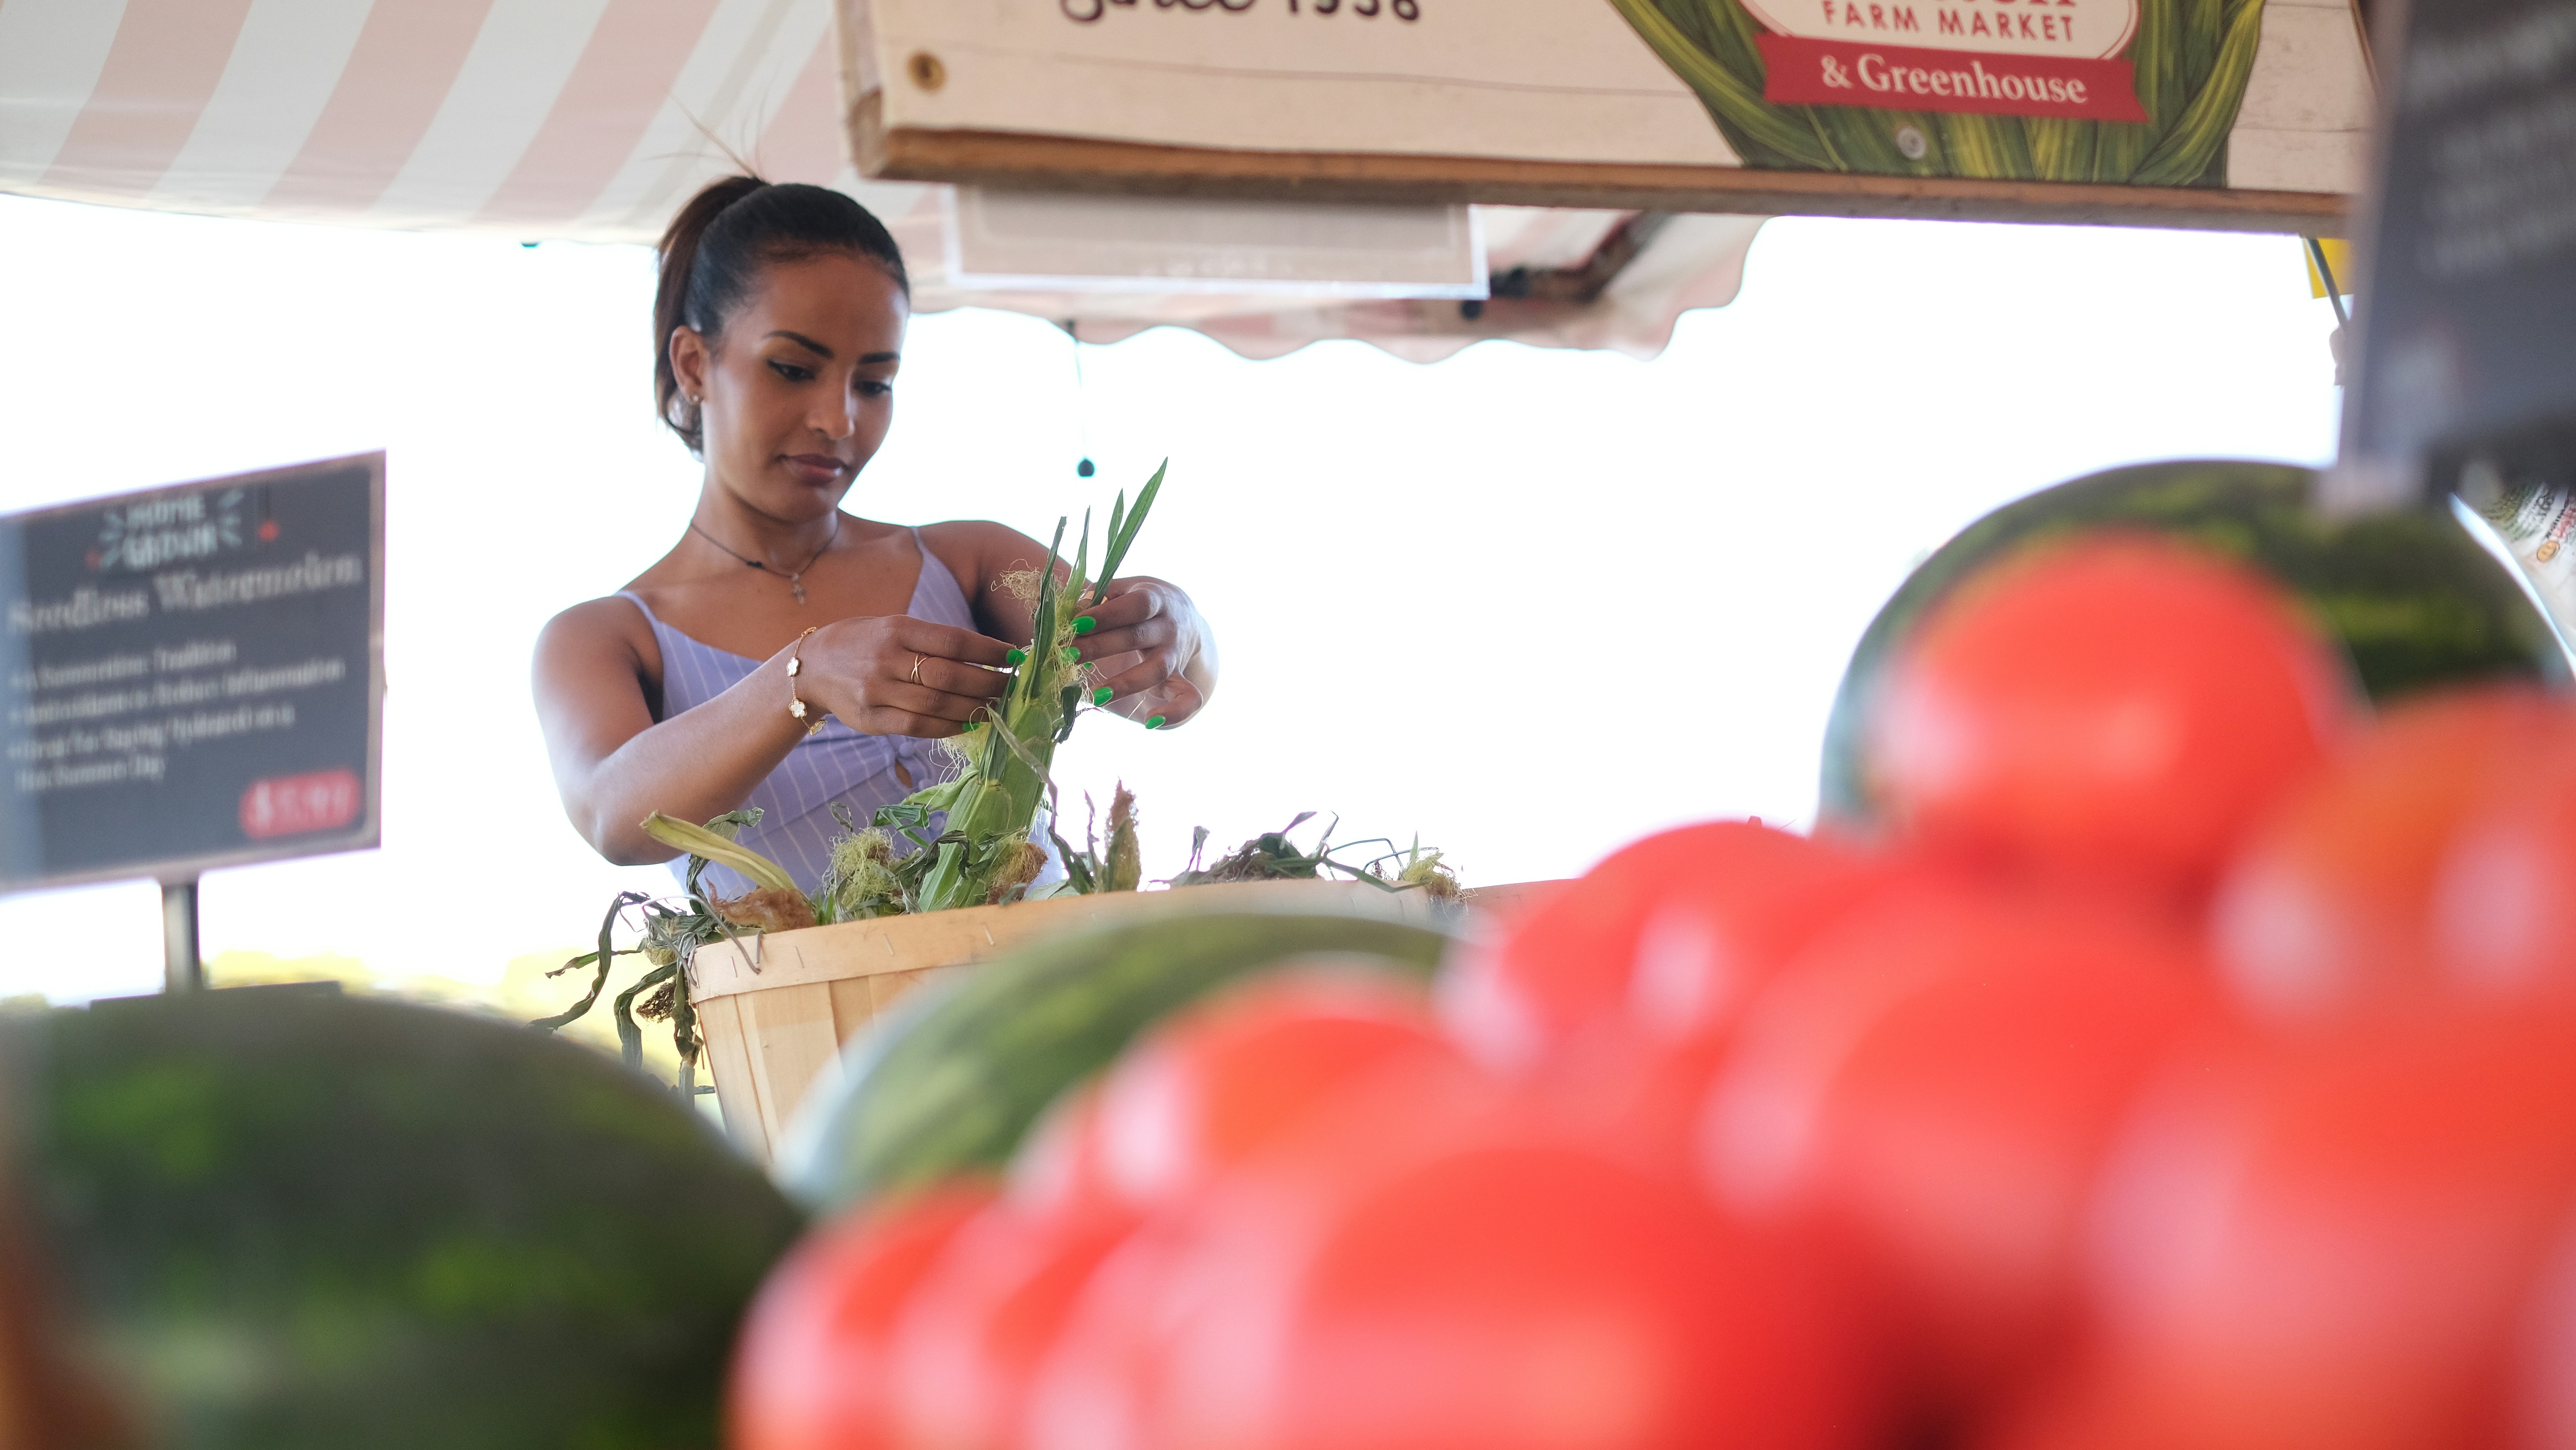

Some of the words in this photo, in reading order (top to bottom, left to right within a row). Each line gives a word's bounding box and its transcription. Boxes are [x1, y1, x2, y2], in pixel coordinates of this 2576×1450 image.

[1822, 1, 1920, 33] FARM
[1938, 8, 2074, 42] MARKET
[1820, 55, 1852, 89] &
[1857, 52, 2088, 104] Greenhouse
